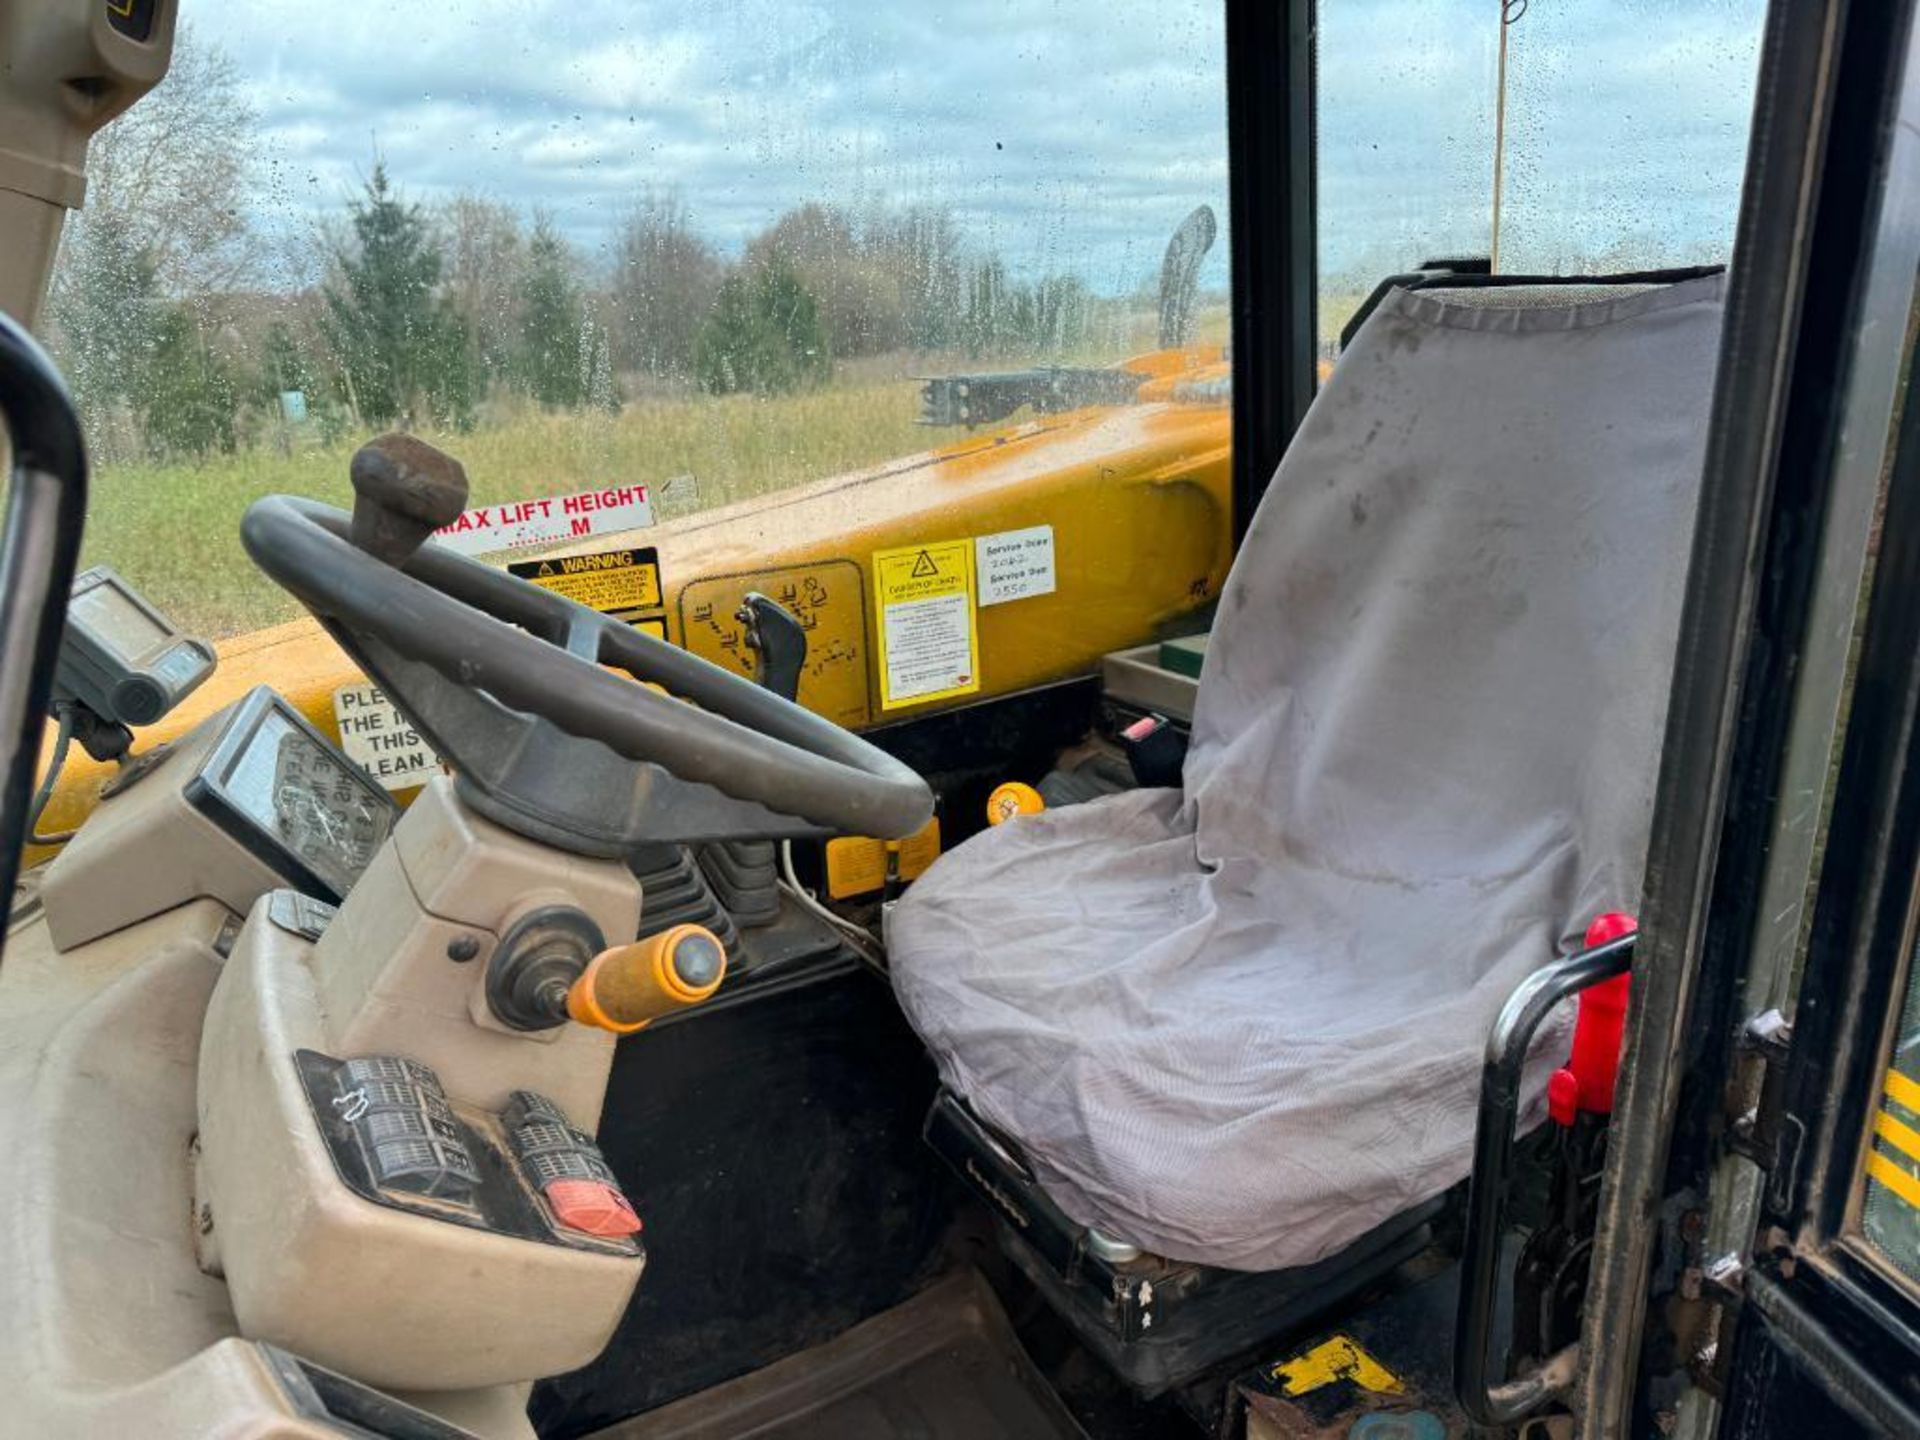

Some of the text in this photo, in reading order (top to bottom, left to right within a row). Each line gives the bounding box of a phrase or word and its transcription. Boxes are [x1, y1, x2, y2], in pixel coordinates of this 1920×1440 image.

[500, 501, 551, 524] LIFT
[564, 486, 646, 514] HEIGHT
[561, 552, 633, 574] WARNING
[342, 689, 385, 709] PLE
[340, 713, 383, 735] THE
[368, 730, 419, 751] THIS
[364, 753, 424, 775] LEAN
